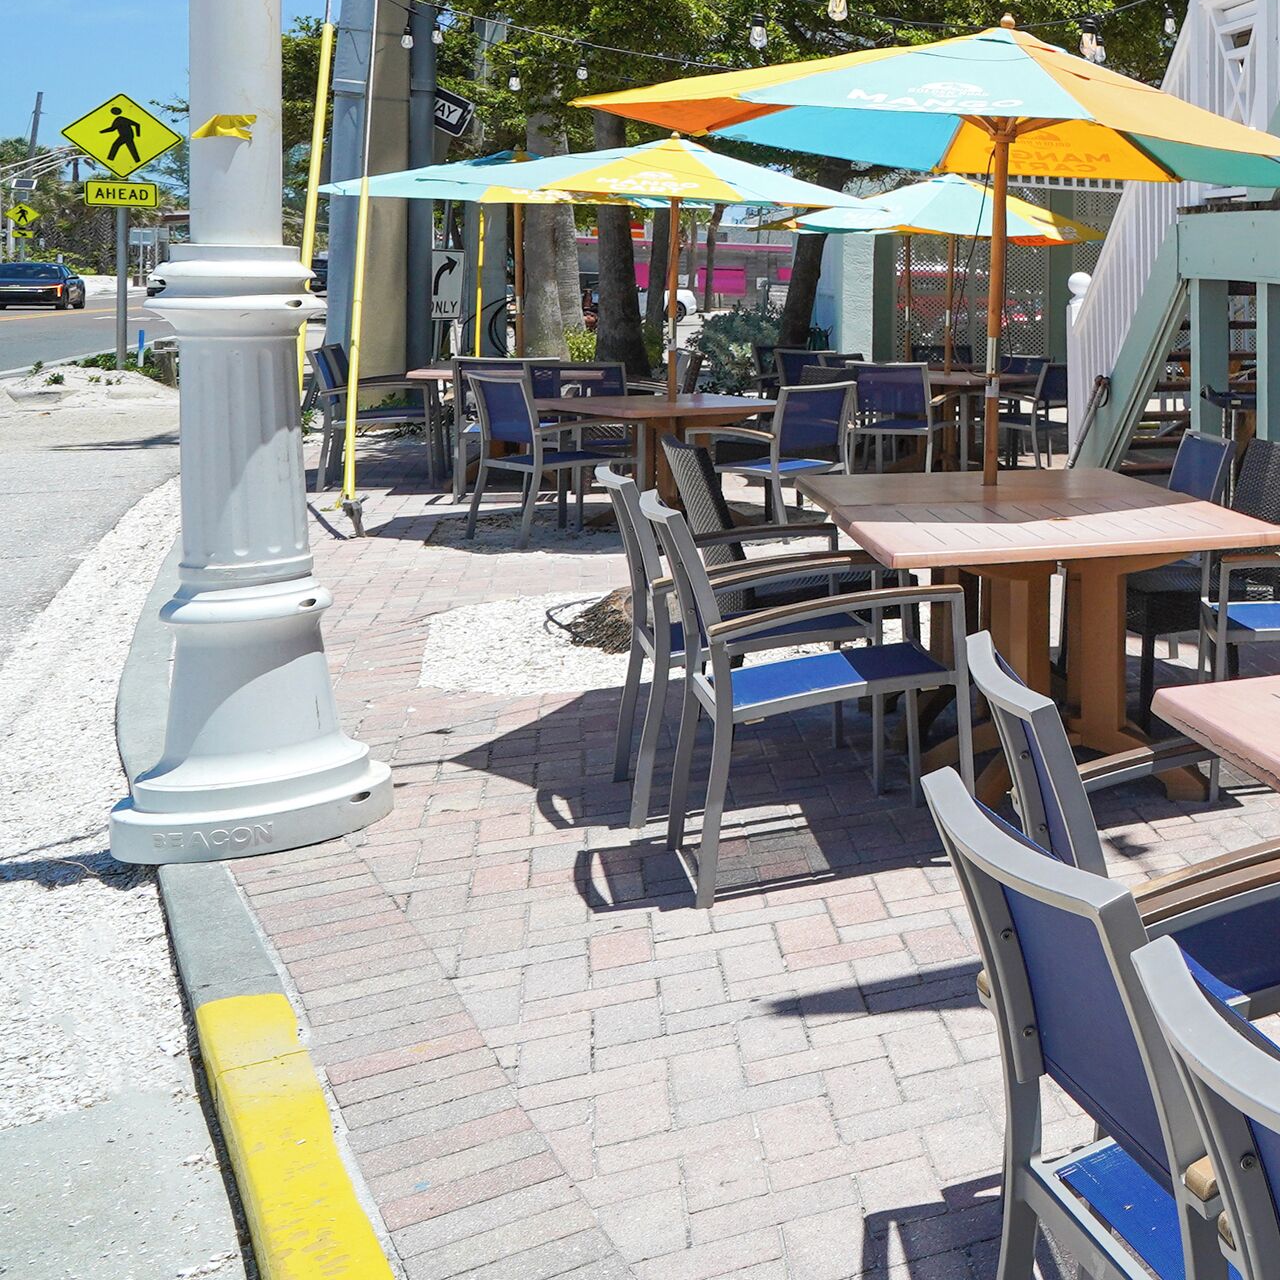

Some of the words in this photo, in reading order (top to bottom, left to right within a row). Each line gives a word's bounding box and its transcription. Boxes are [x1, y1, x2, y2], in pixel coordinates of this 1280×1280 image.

[847, 88, 1024, 107] MANGO
[433, 100, 458, 119] AY
[596, 177, 700, 189] MANGO
[95, 187, 149, 201] AHEAD
[152, 821, 274, 850] BEACON
